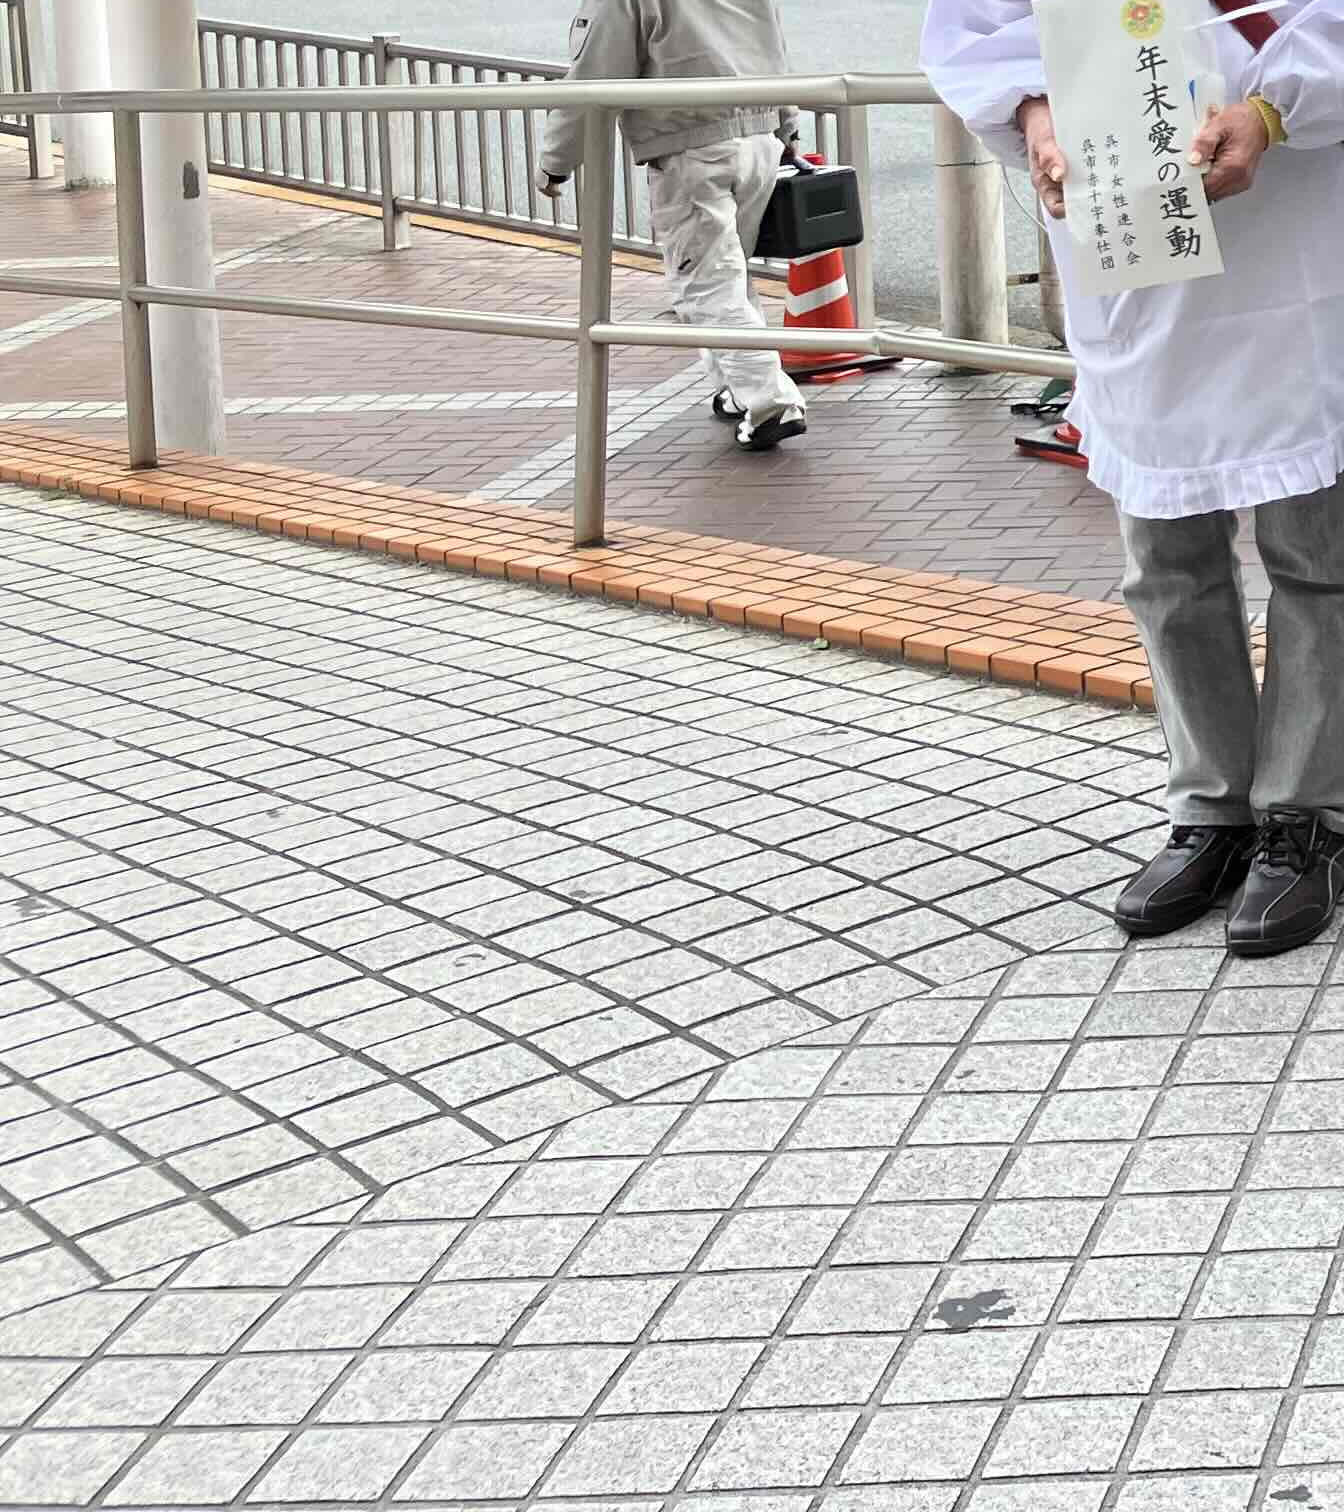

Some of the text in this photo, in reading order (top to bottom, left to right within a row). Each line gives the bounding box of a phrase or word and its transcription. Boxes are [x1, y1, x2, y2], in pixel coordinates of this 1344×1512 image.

[1135, 45, 1201, 258] 年末愛の運動
